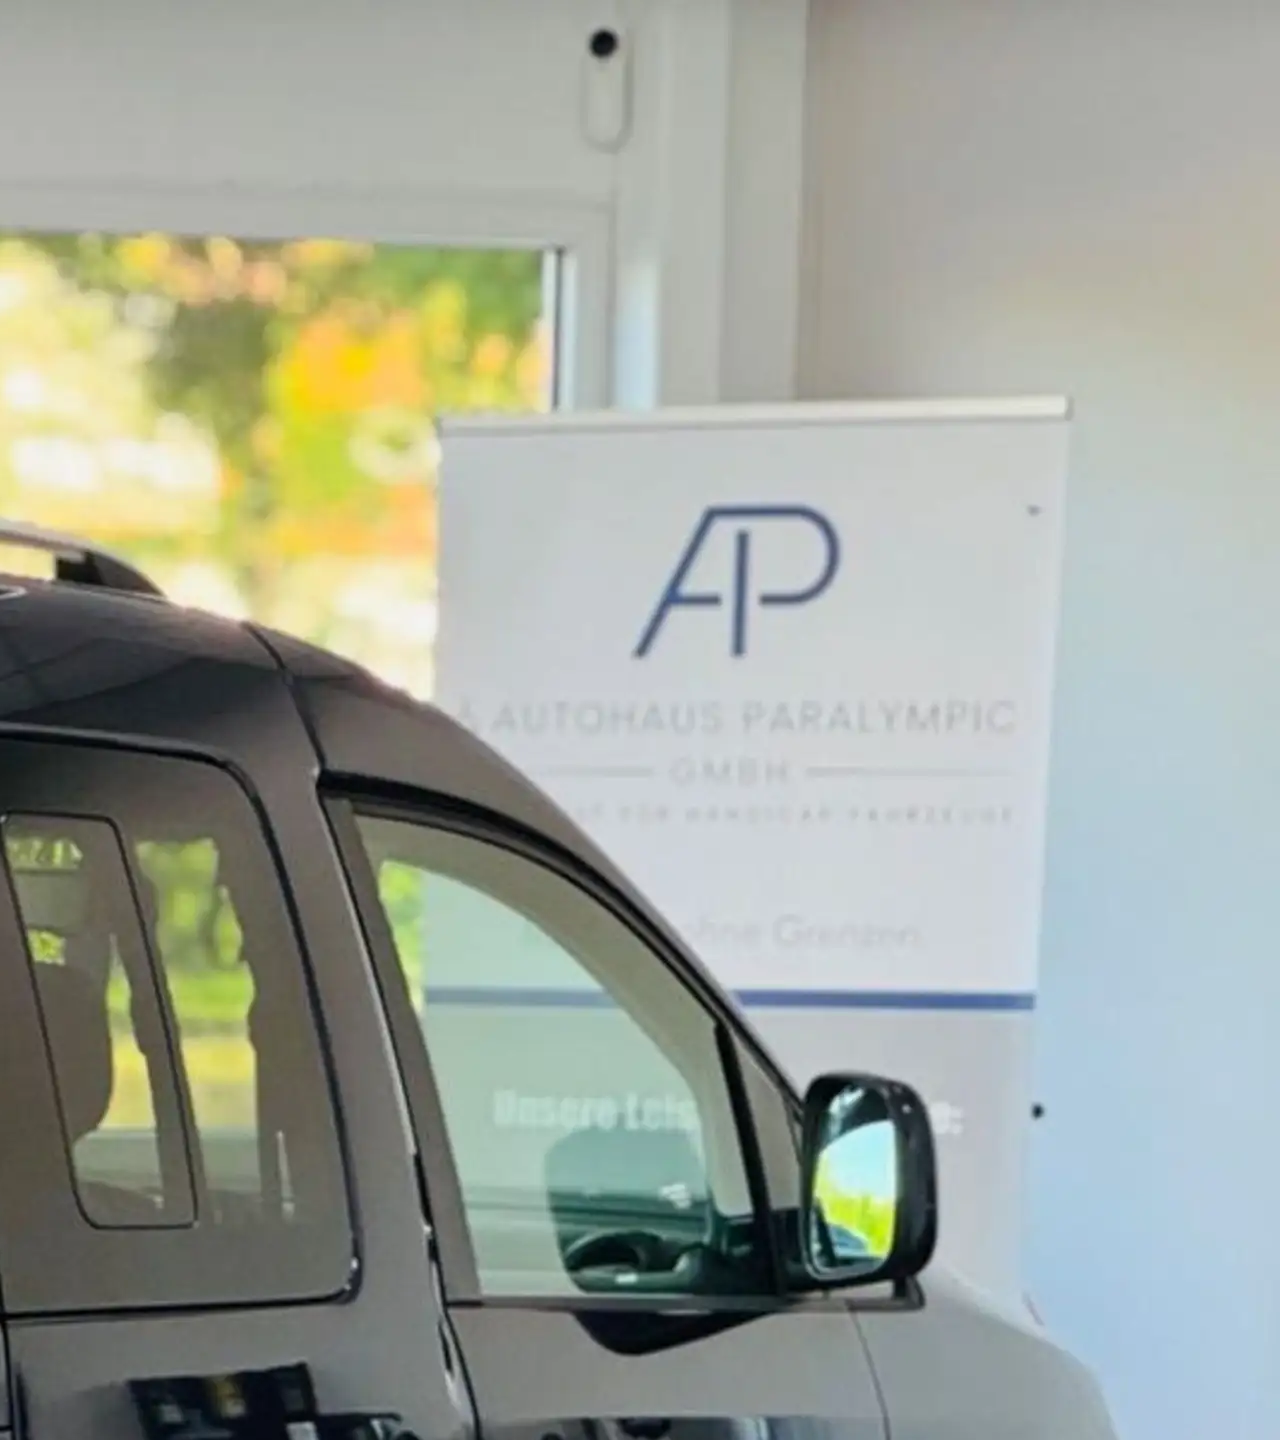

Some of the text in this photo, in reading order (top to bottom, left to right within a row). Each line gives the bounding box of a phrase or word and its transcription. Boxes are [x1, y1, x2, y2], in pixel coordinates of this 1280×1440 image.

[491, 699, 1017, 735] AUTOHAUS PARALYMPIC
[668, 756, 790, 787] GMBH
